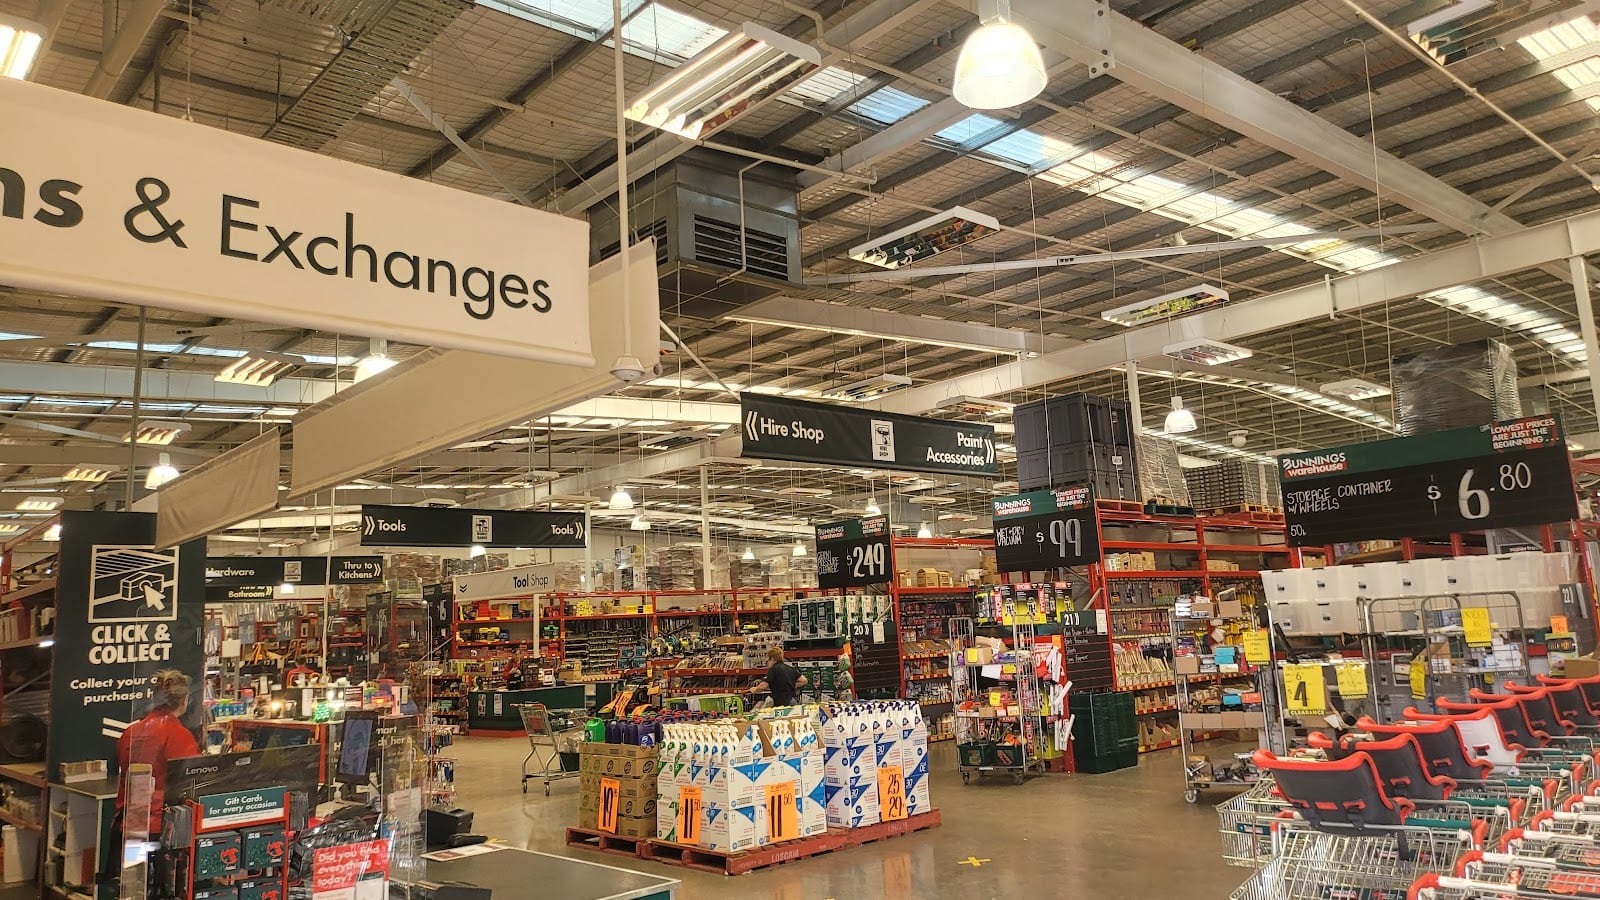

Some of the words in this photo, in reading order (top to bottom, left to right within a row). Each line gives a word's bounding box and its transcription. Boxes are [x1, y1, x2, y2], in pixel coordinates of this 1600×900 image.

[124, 177, 188, 249] &
[220, 194, 553, 321] Exchanges
[760, 417, 789, 437] Hire
[792, 421, 824, 444] Shop
[1491, 423, 1524, 434] LOWEST
[1526, 418, 1556, 428] PRICES
[957, 432, 983, 449] Paint
[1492, 433, 1509, 442] ARE
[1510, 430, 1531, 439] JUST
[1531, 427, 1549, 435] THE
[926, 447, 985, 466] Accessories
[1282, 452, 1346, 470] BUNNINGS
[1287, 462, 1344, 477] warehouse
[1287, 487, 1331, 505] STORAGE
[1337, 479, 1393, 498] CONTAINER
[994, 498, 1031, 510] BUNNINGS
[997, 506, 1031, 516] warehouse
[1299, 498, 1340, 514] WHEELS
[377, 519, 407, 532] Tools
[551, 524, 574, 535] Tools
[1049, 518, 1081, 558] 99
[343, 561, 362, 570] Thru
[364, 562, 373, 570] to
[853, 543, 885, 578] 249
[338, 570, 373, 579] Kitchens
[513, 574, 529, 588] Tool
[530, 574, 549, 589] Shop
[228, 590, 265, 598] Bathroom
[1064, 613, 1073, 626] 21
[91, 624, 149, 644] CLICK
[154, 623, 171, 641] &
[853, 625, 864, 635] 20
[88, 642, 173, 665] COLLECT
[70, 678, 113, 689] Collect
[117, 677, 147, 689] your
[83, 690, 143, 706] purchase
[1294, 681, 1308, 707] 4
[877, 745, 885, 753] 30
[185, 766, 219, 775] Lenovo
[887, 774, 900, 794] 25
[209, 807, 221, 815] for
[222, 805, 244, 814] every
[245, 800, 277, 810] occasion
[224, 797, 239, 806] Gift
[241, 794, 263, 804] Cards
[602, 786, 614, 828] 19
[888, 796, 902, 818] 29
[318, 850, 336, 862] Did
[338, 849, 357, 861] you
[317, 860, 372, 875] everything
[318, 872, 353, 886] today?
